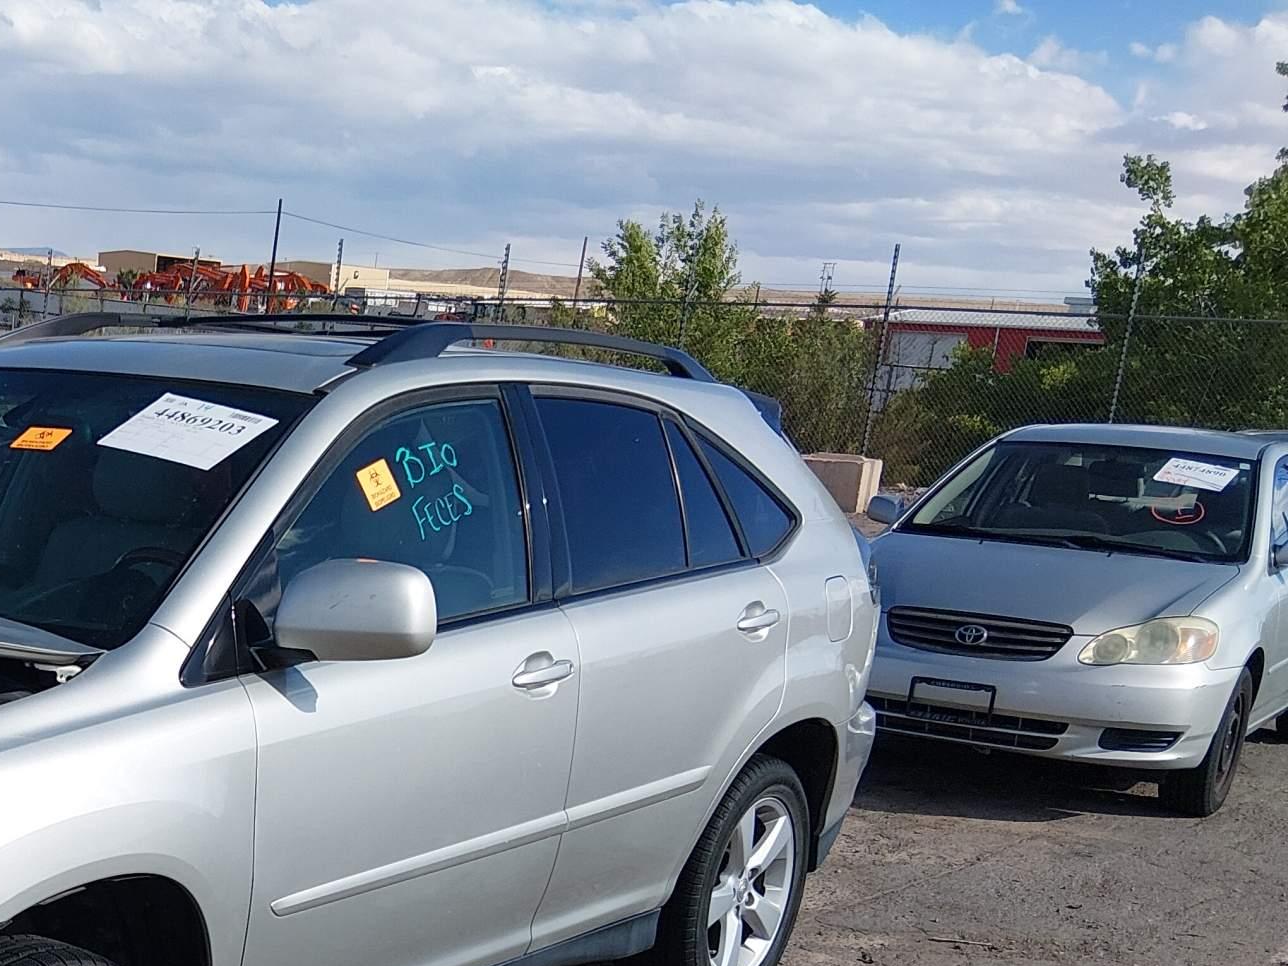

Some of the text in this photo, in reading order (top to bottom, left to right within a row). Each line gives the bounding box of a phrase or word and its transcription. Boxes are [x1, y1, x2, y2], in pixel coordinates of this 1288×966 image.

[154, 408, 247, 436] 44869203
[396, 442, 457, 488] BIO
[412, 483, 473, 540] FECES
